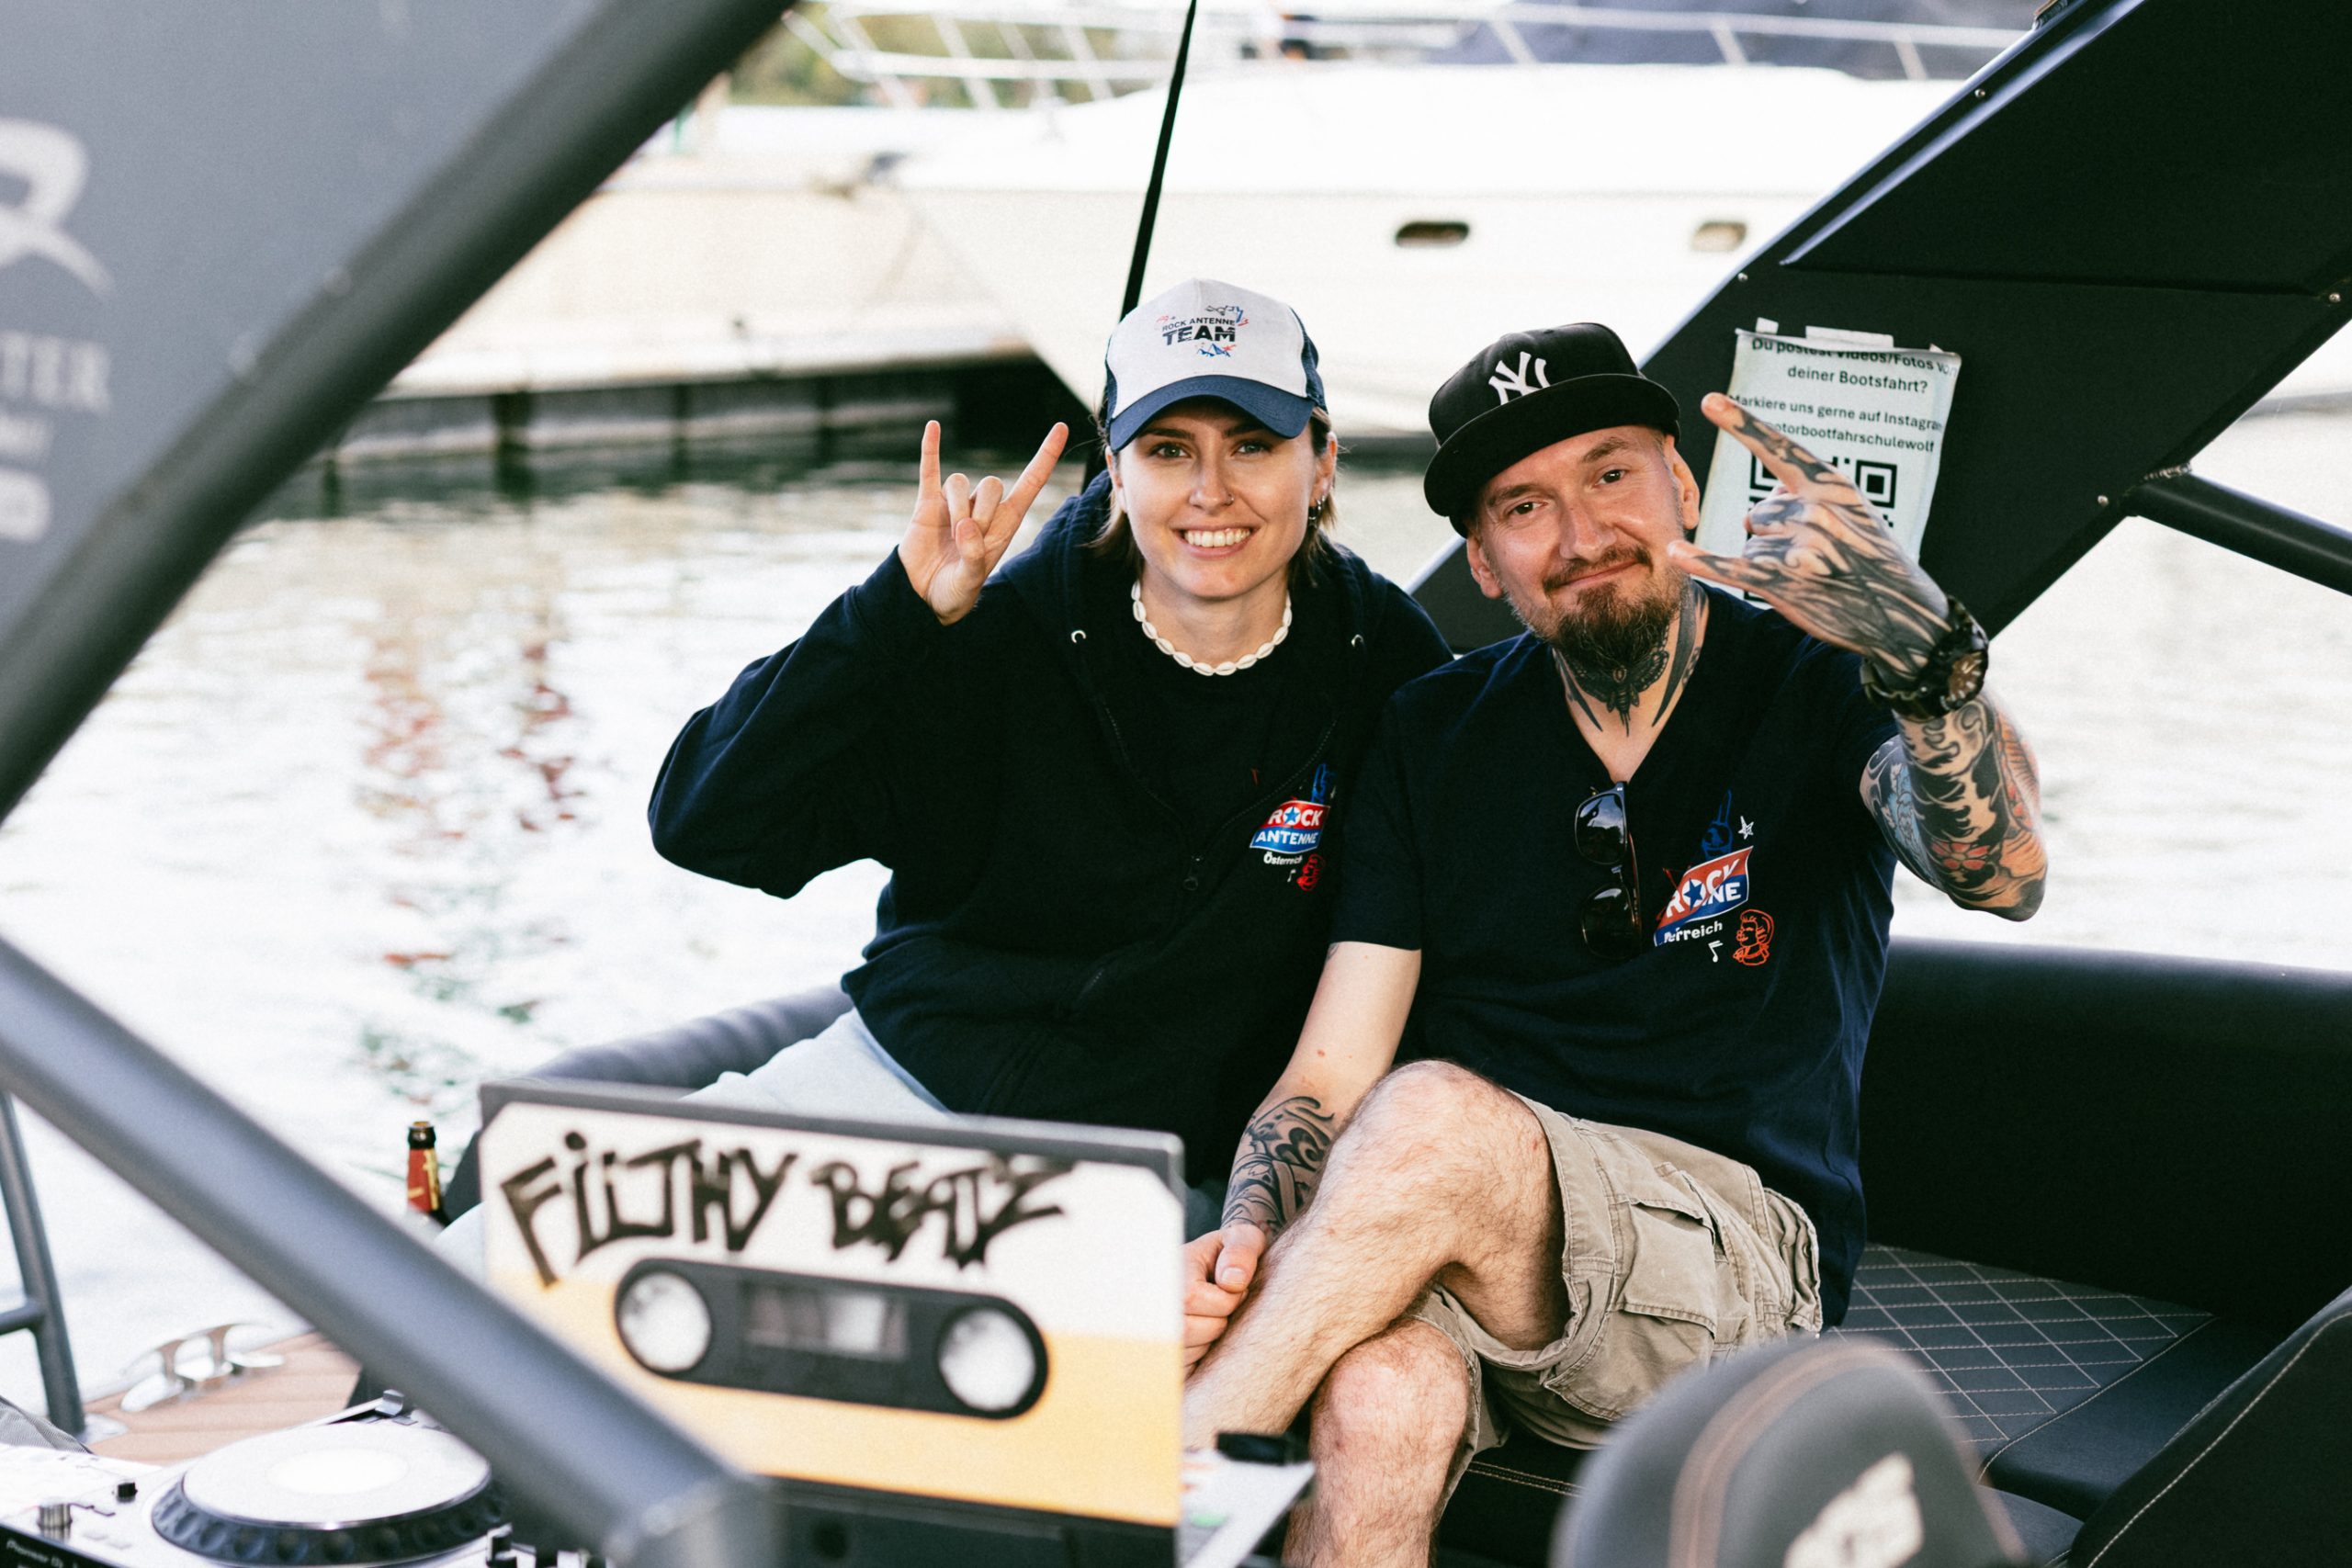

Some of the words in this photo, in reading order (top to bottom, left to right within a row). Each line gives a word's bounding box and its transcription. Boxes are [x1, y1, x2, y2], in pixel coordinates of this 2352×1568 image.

[1162, 321, 1187, 332] ROCK
[1189, 317, 1236, 326] ANTENNE
[1162, 324, 1236, 345] TEAM
[1752, 337, 1773, 351] Du
[1488, 351, 1551, 405] NY
[1788, 366, 1836, 382] deiner
[1839, 370, 1928, 393] Bootsfahrt?
[1790, 403, 1814, 414] uns
[1817, 405, 1856, 418] gerne
[1859, 411, 1881, 423] auf
[1268, 806, 1324, 827] ROCK
[1255, 830, 1319, 845] ANTENNE
